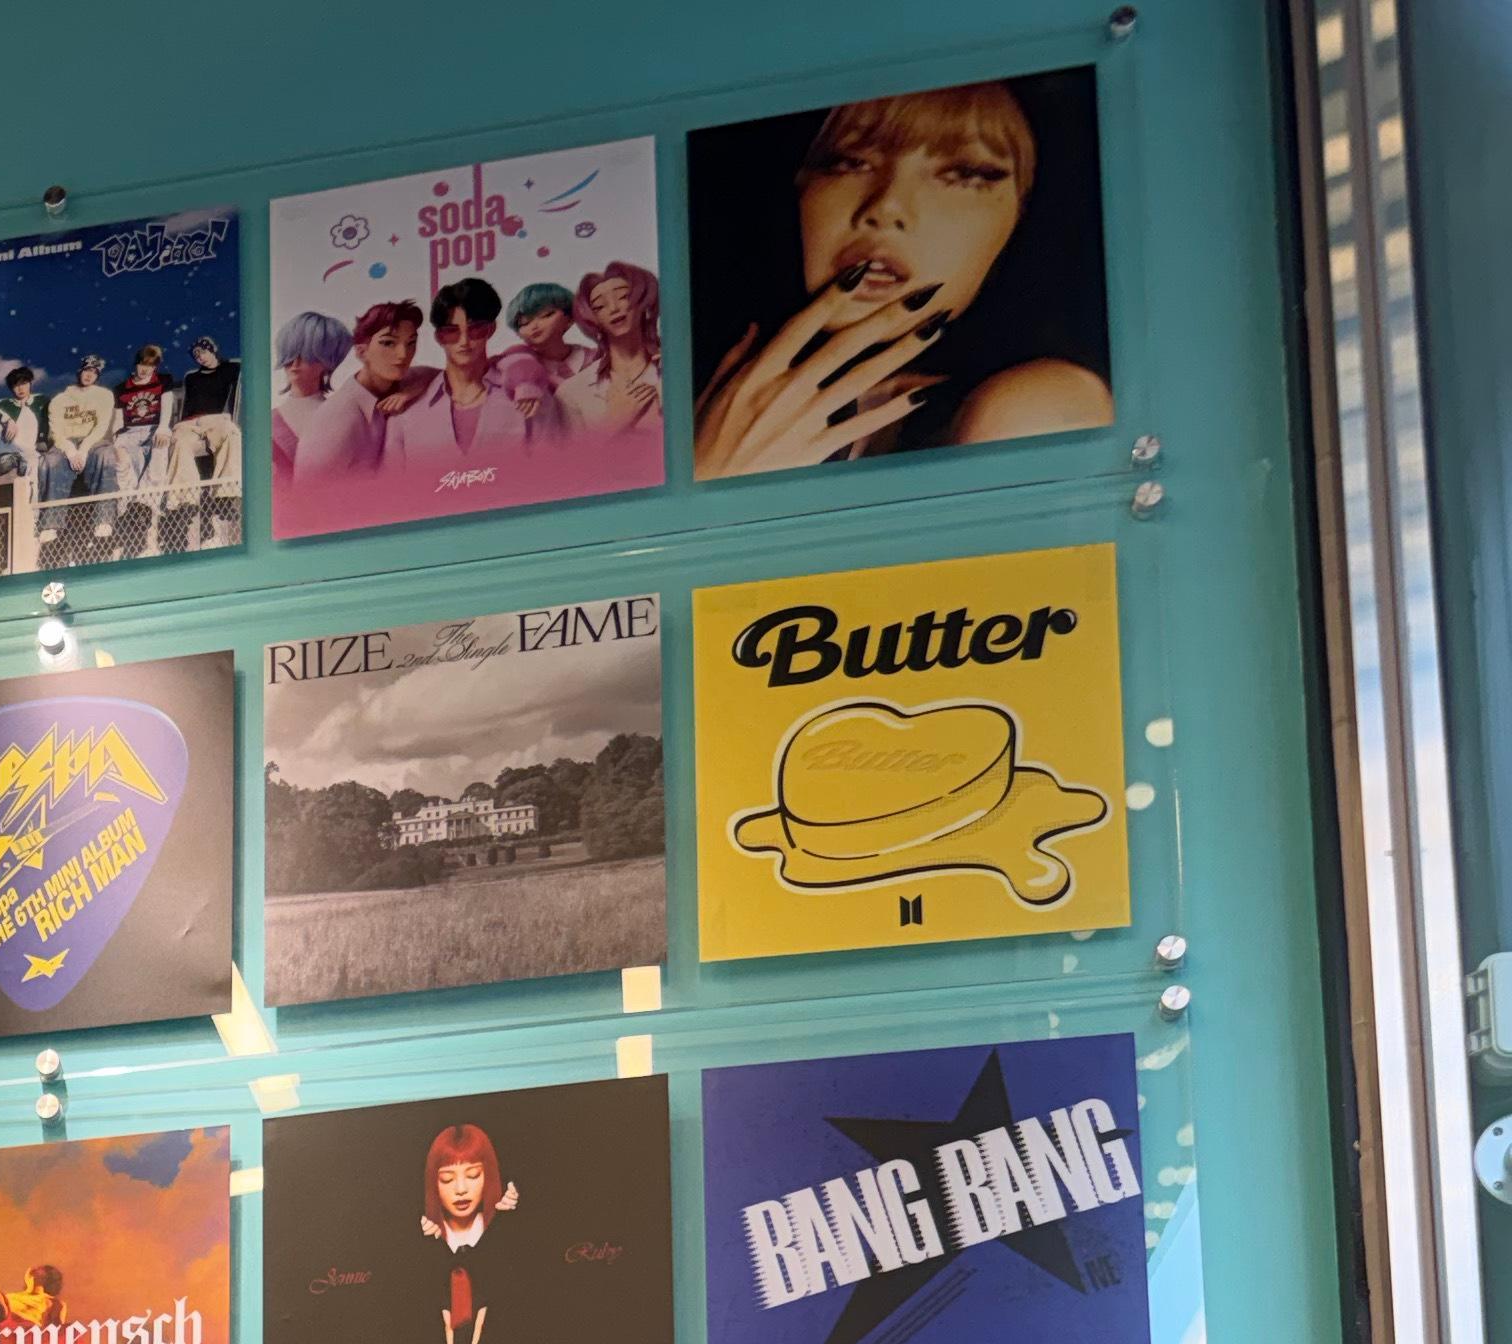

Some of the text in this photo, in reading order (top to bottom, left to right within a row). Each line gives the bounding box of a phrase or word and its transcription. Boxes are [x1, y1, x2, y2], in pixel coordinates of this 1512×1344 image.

[418, 163, 505, 238] soda
[17, 240, 83, 260] Album
[430, 230, 496, 300] pop
[268, 631, 394, 685] RIIZE
[517, 597, 658, 653] FAME
[731, 604, 1078, 689] Butter
[14, 891, 47, 924] 6TH
[44, 855, 82, 898] MINI
[80, 806, 137, 870] ALBUM
[33, 824, 147, 943] RICH MAN
[740, 1098, 1143, 1312] BANG BANG
